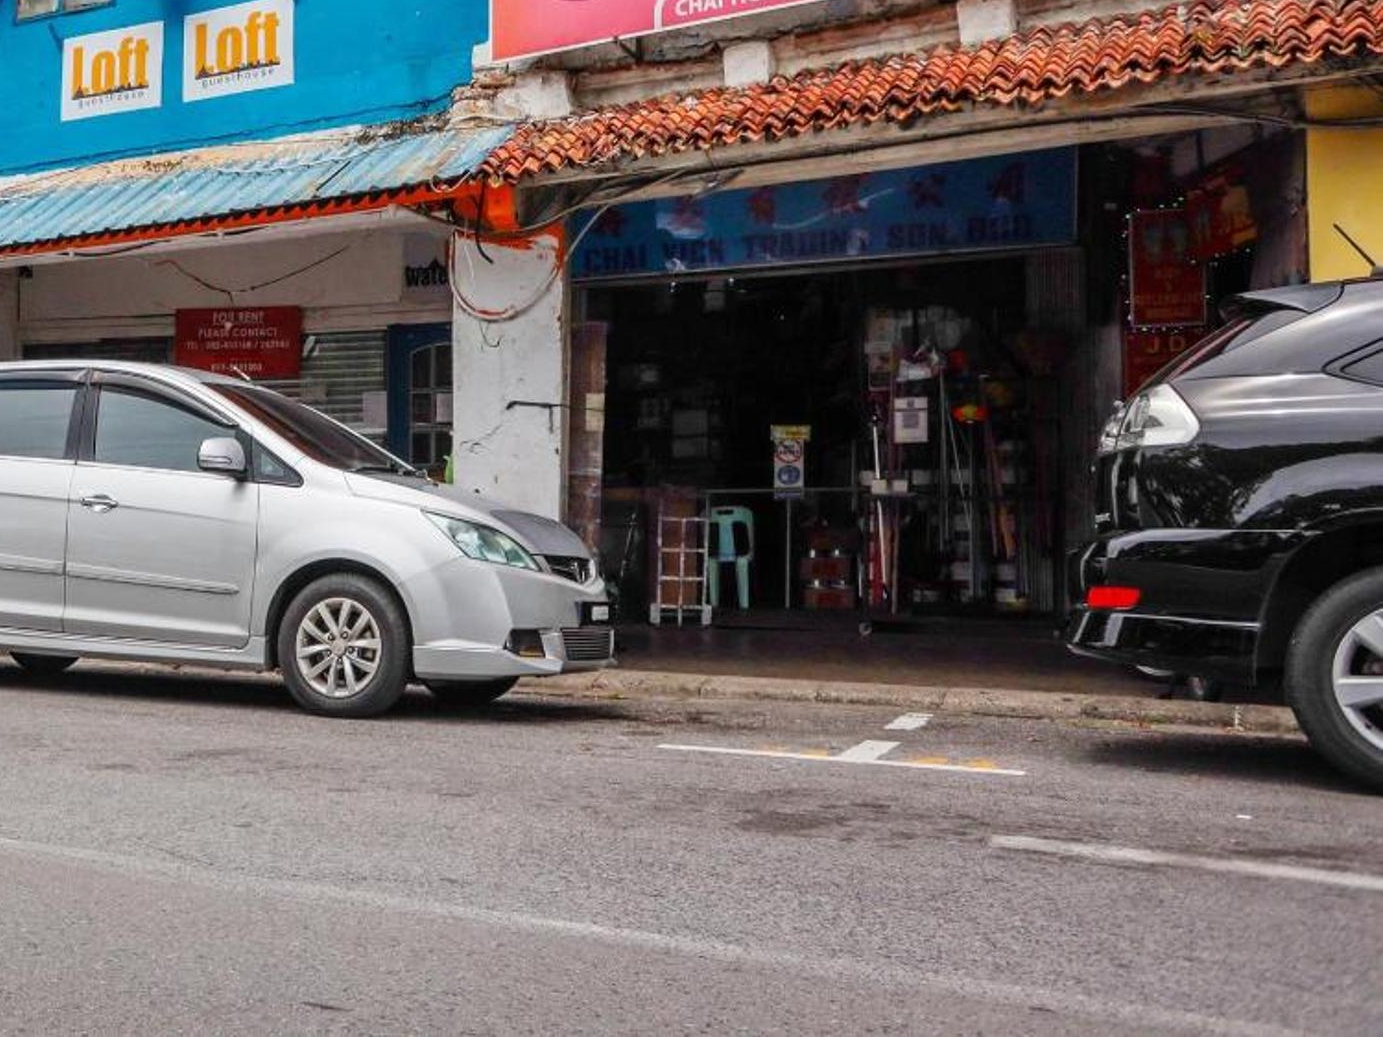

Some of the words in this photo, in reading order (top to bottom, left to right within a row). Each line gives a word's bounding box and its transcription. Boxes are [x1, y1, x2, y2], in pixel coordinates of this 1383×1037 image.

[195, 11, 280, 78] Loft
[72, 36, 150, 99] Loft
[202, 68, 275, 89] guesthouse
[232, 326, 277, 338] CONTACT
